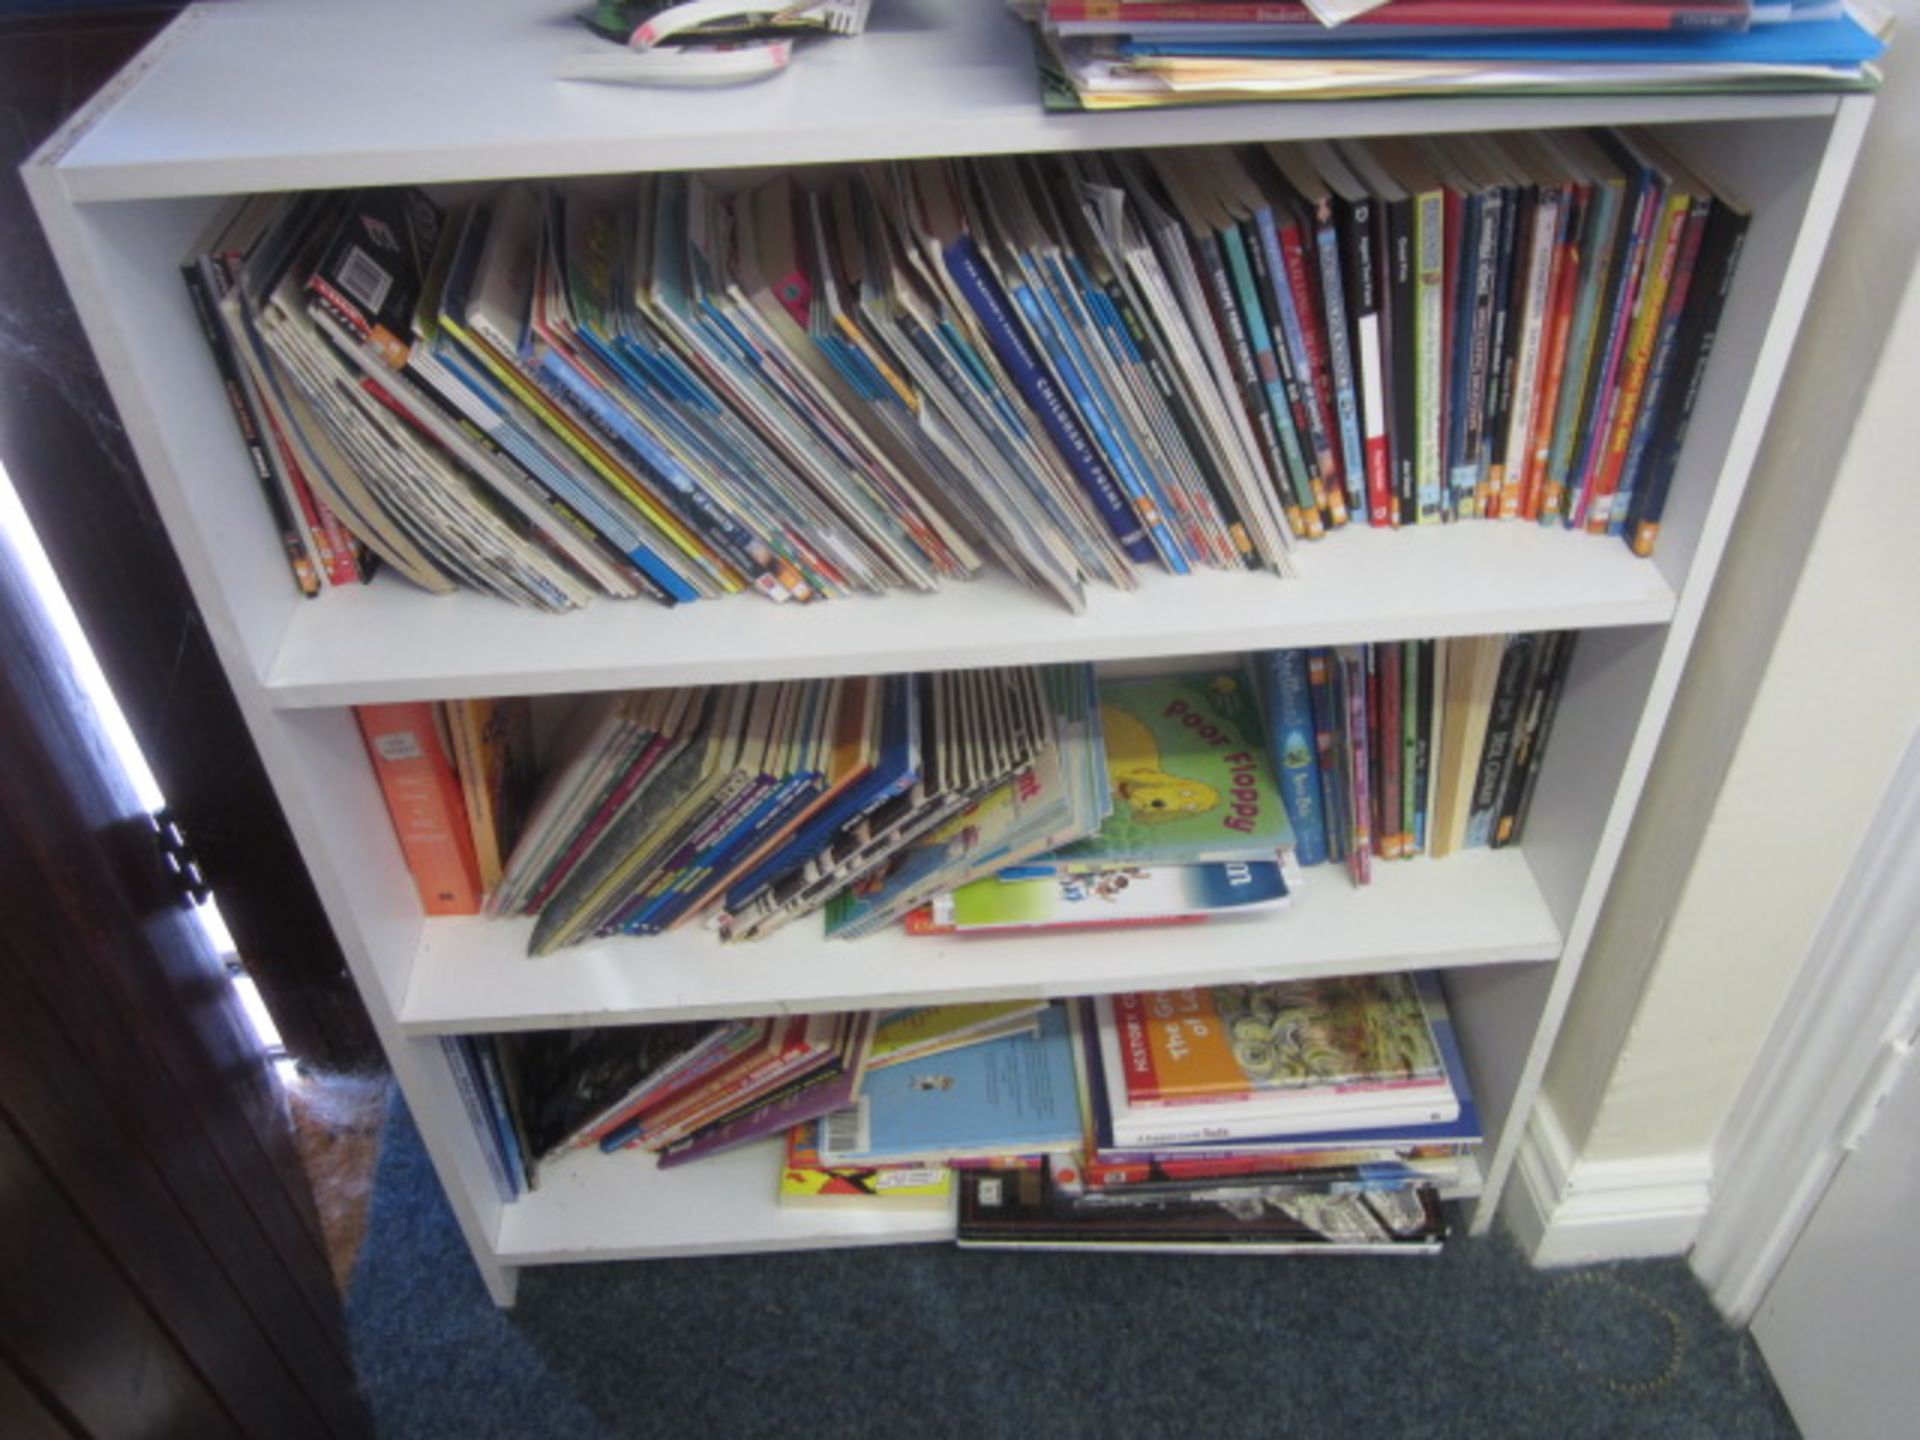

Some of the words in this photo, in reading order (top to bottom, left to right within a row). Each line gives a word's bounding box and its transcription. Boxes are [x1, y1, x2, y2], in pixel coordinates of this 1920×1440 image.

[1036, 376, 1093, 465] CHILDREN'S
[1090, 465, 1124, 513] POEMS
[1162, 698, 1231, 746] Poor
[1222, 750, 1259, 834] Floppy
[1126, 1014, 1150, 1073] HISTORY
[1164, 1022, 1191, 1063] The
